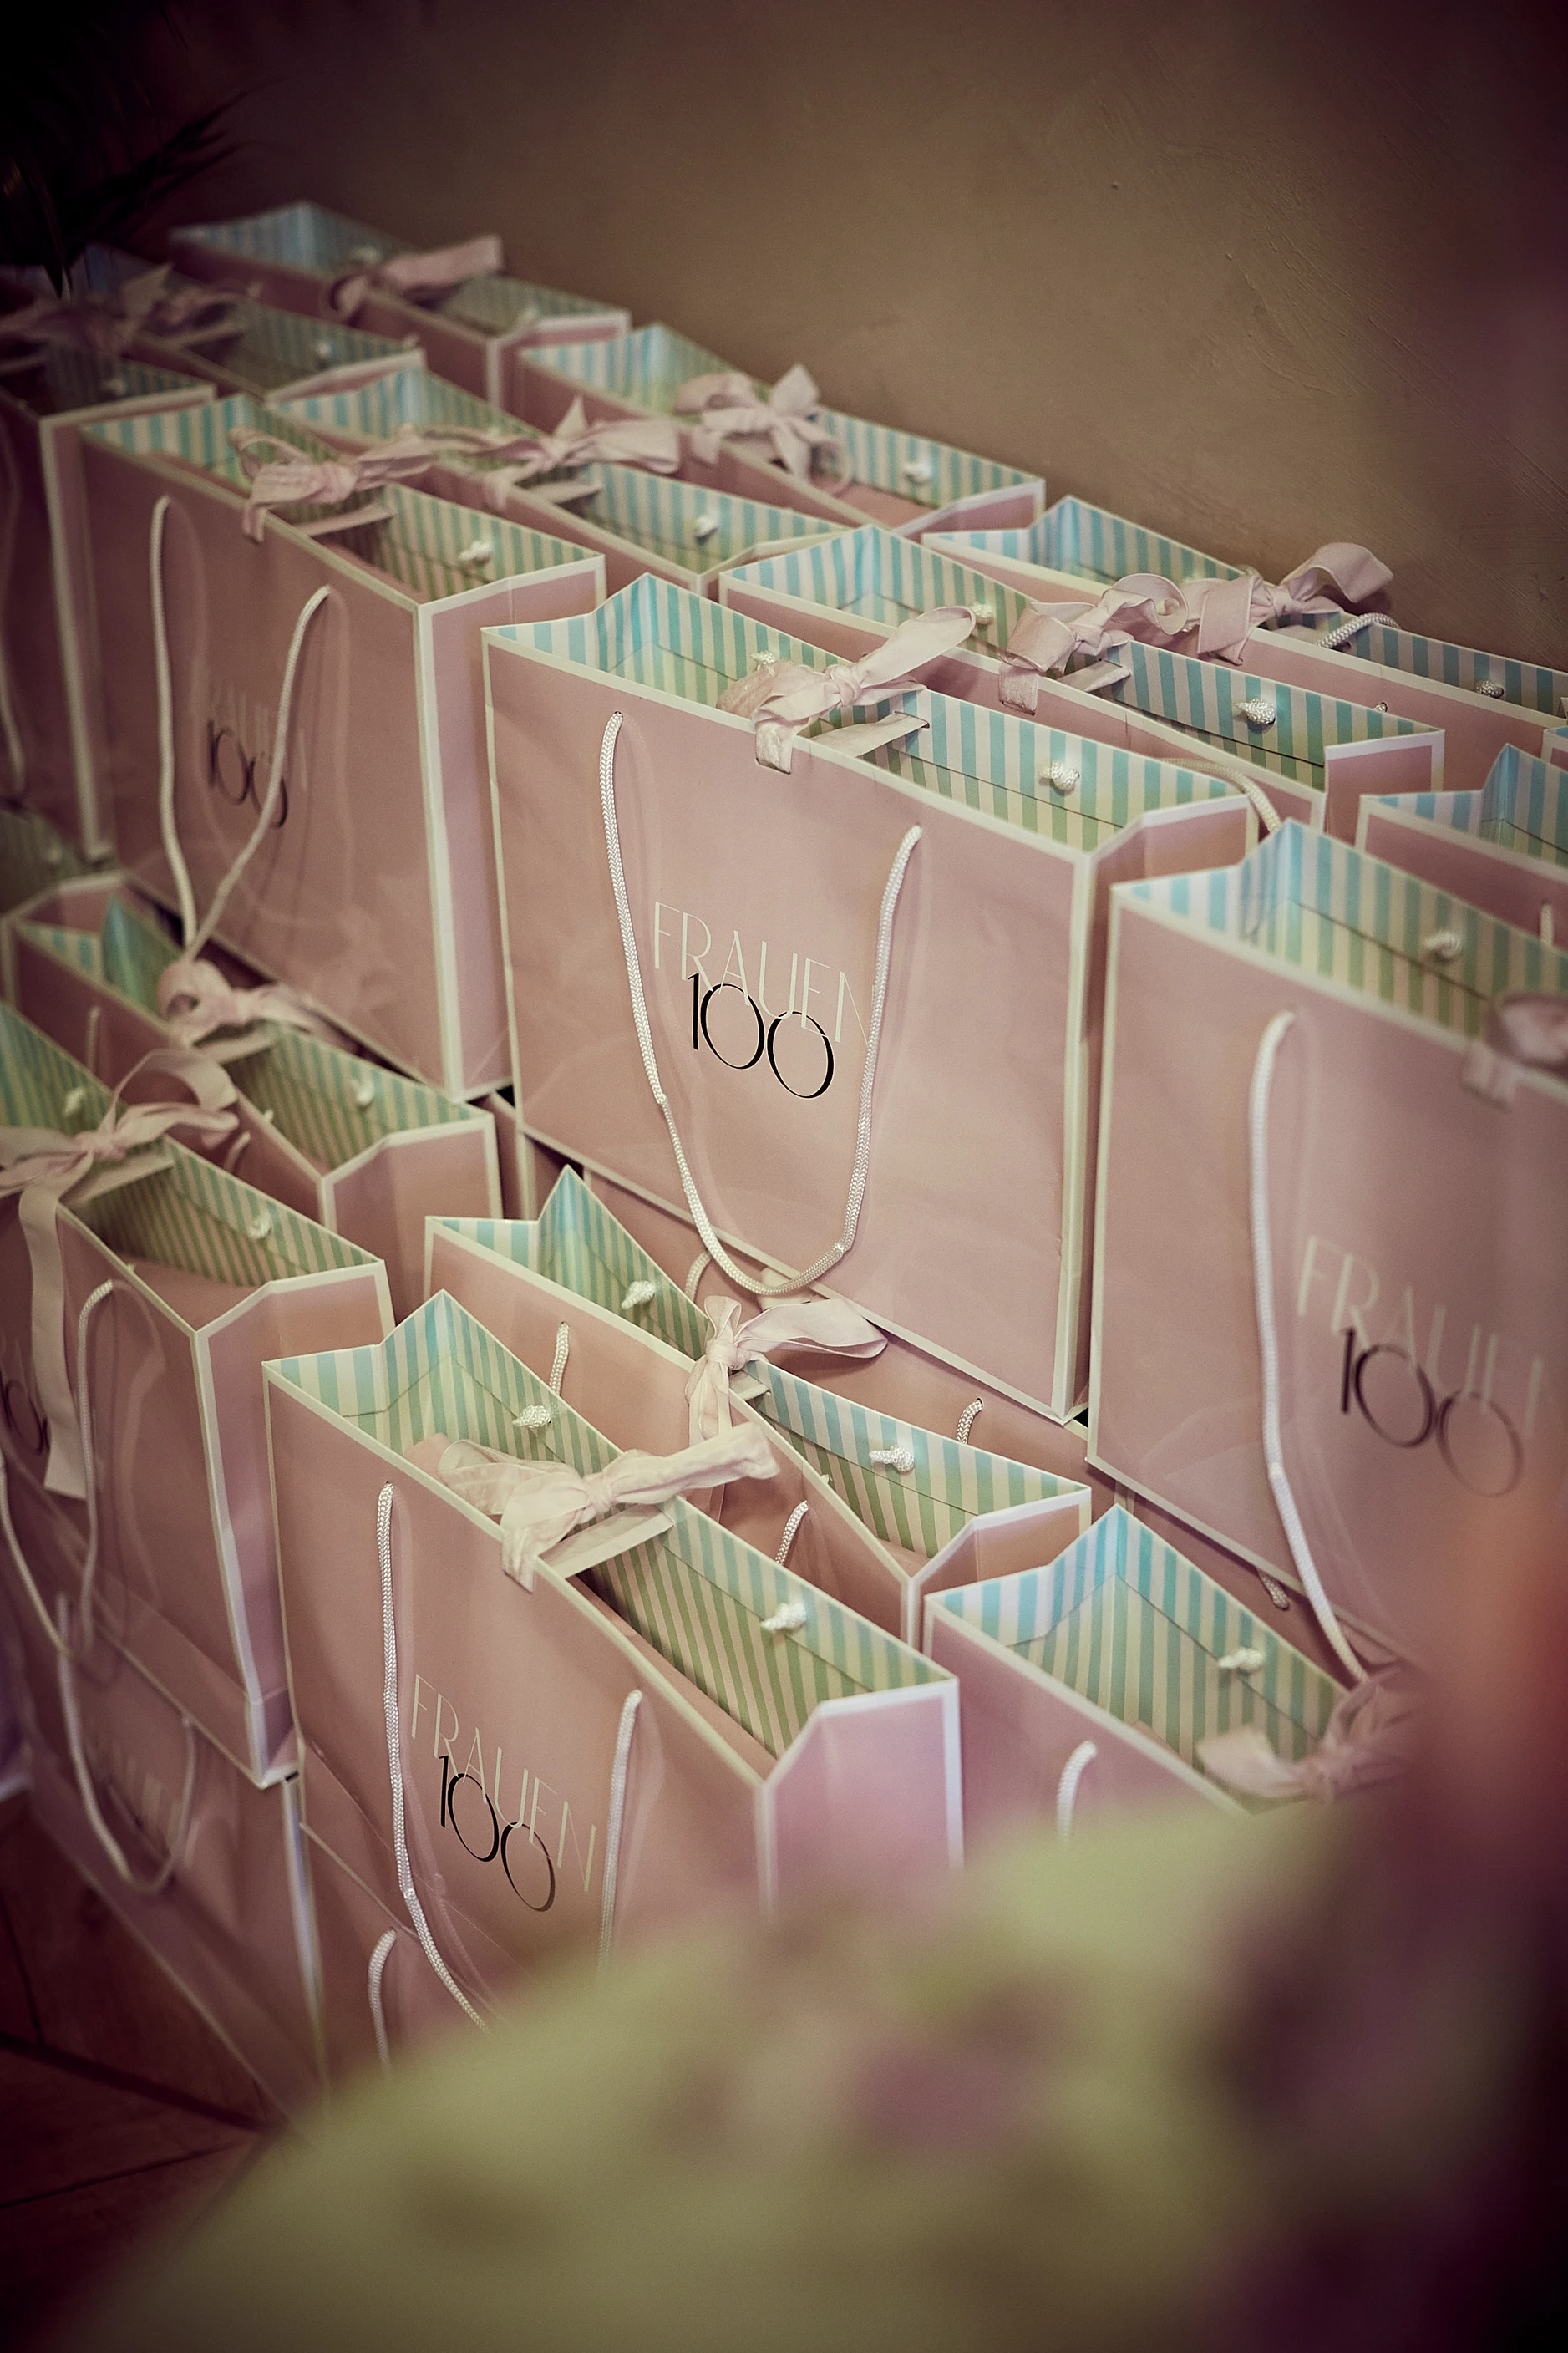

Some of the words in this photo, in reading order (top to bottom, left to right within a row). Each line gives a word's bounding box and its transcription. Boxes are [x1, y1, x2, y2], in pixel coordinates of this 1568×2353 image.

[688, 973, 834, 1100] 100
[1340, 1327, 1524, 1497] 100
[411, 1674, 596, 1892] FRAUEN
[439, 1756, 555, 1912] 100
